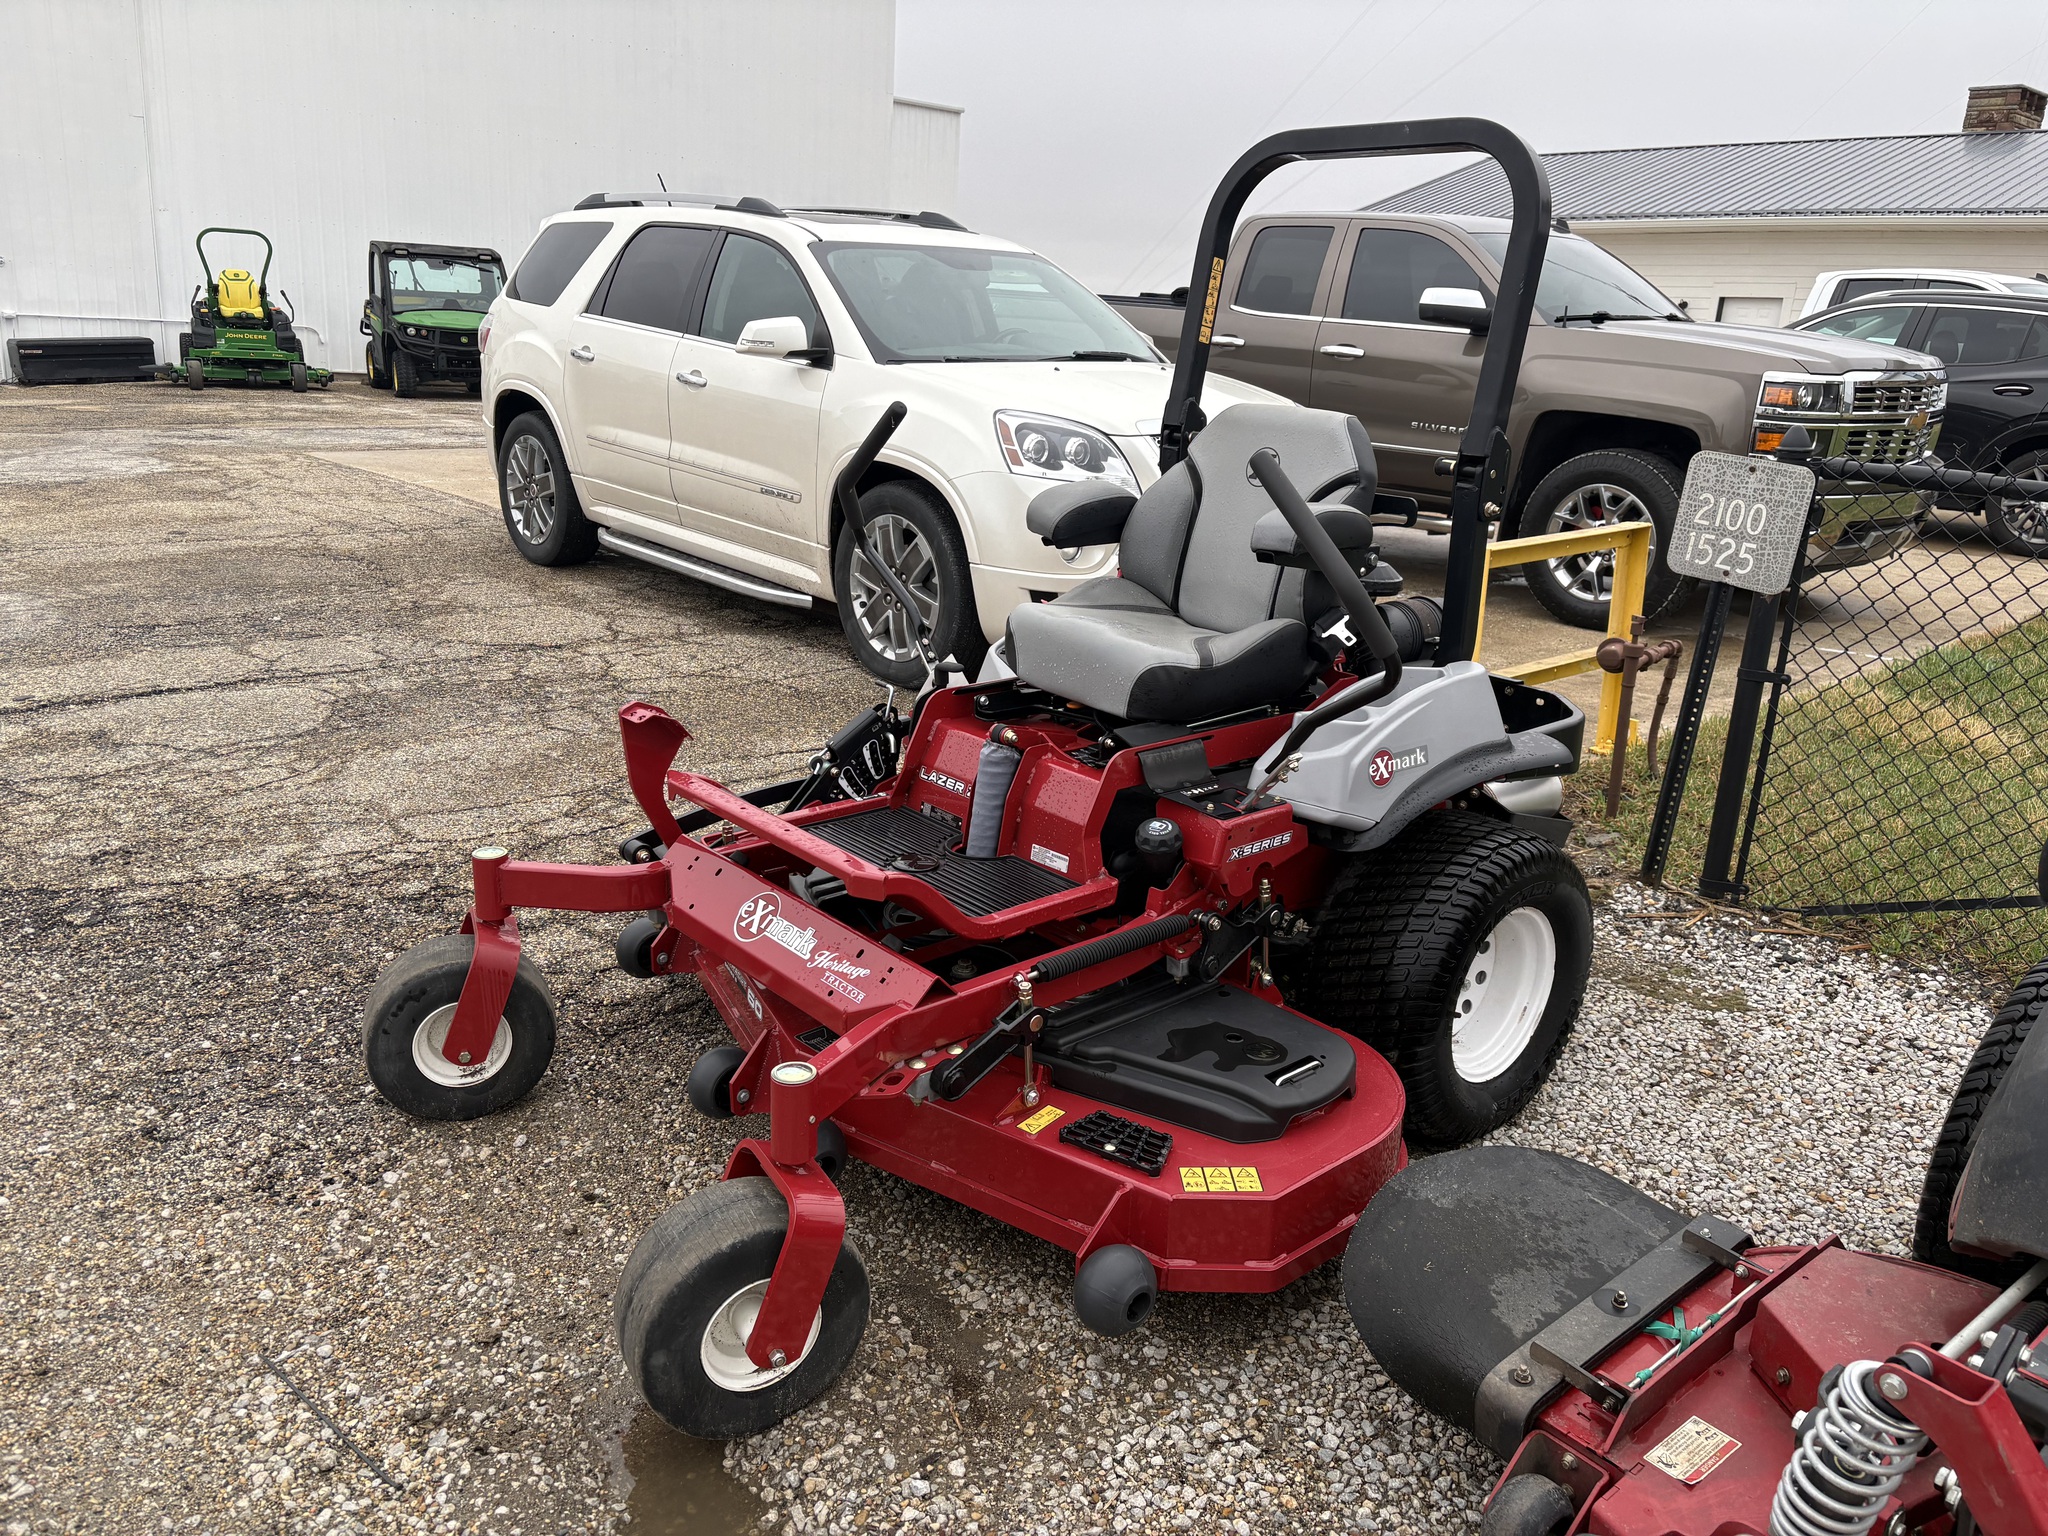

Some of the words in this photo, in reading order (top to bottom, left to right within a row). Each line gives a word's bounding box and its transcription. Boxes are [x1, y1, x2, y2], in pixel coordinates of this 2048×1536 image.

[1693, 492, 1767, 535] 2100
[1684, 531, 1757, 574] 1525
[920, 767, 965, 795] LAZER
[1369, 748, 1426, 781] eXmark
[737, 896, 817, 959] eXmark
[806, 950, 871, 980] Heritage
[747, 987, 763, 1022] 60
[822, 972, 865, 1003] TRACTOR
